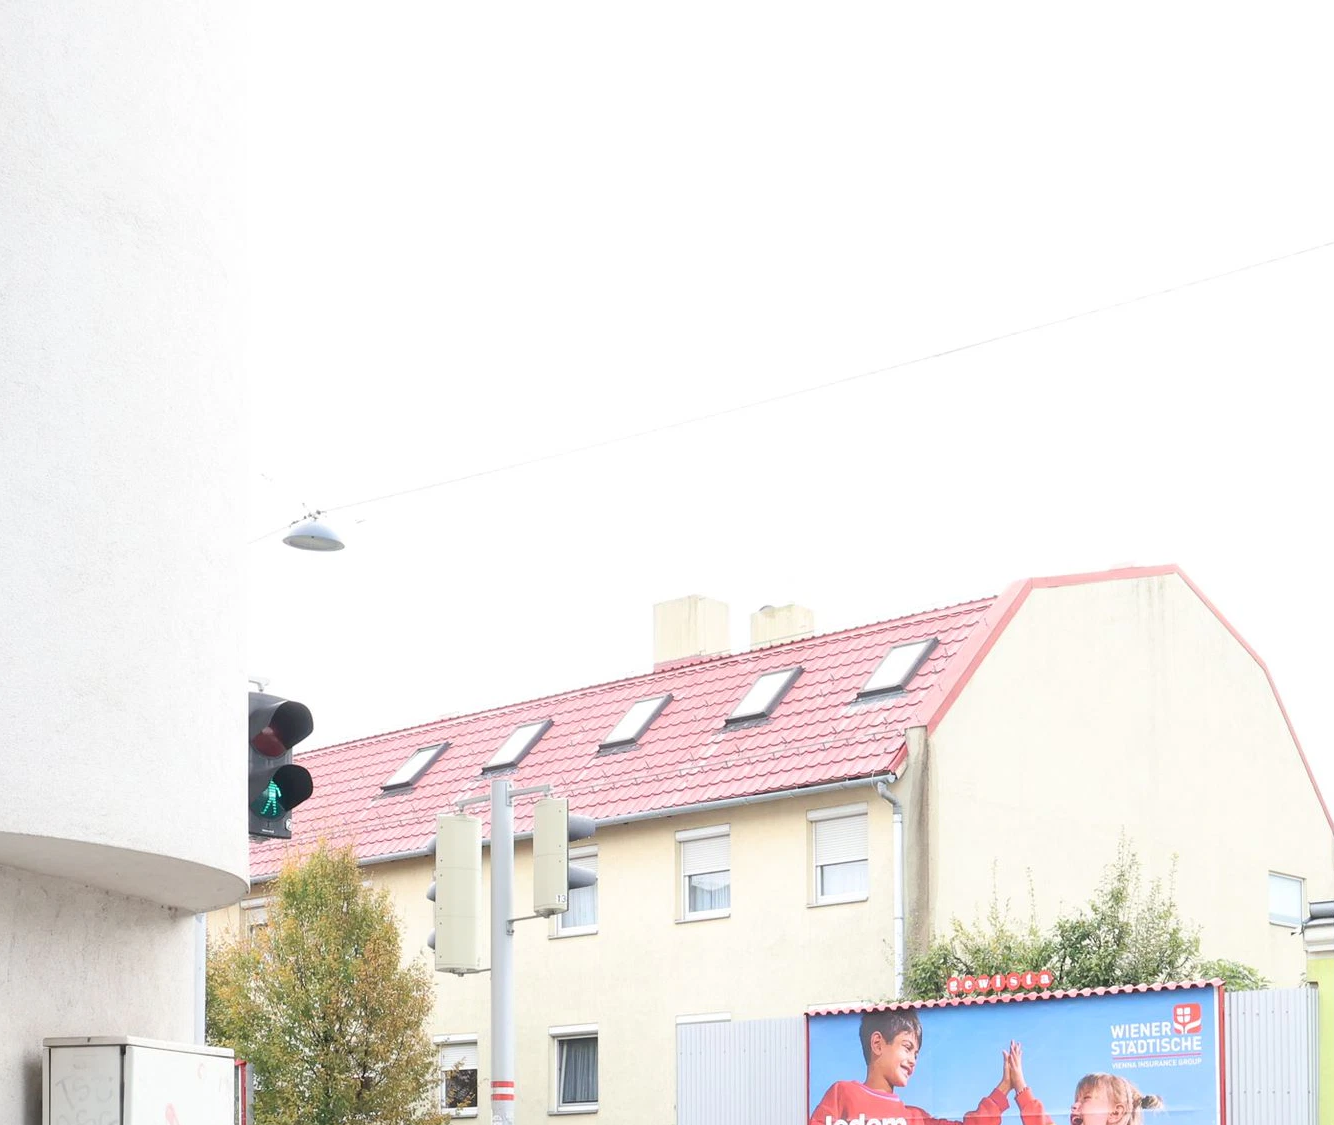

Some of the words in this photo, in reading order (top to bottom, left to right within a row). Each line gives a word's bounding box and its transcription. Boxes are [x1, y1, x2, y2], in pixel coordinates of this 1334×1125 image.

[948, 973, 1050, 992] gewista
[1111, 1022, 1171, 1039] WIENER
[1111, 1036, 1202, 1055] STÄDTISCHE
